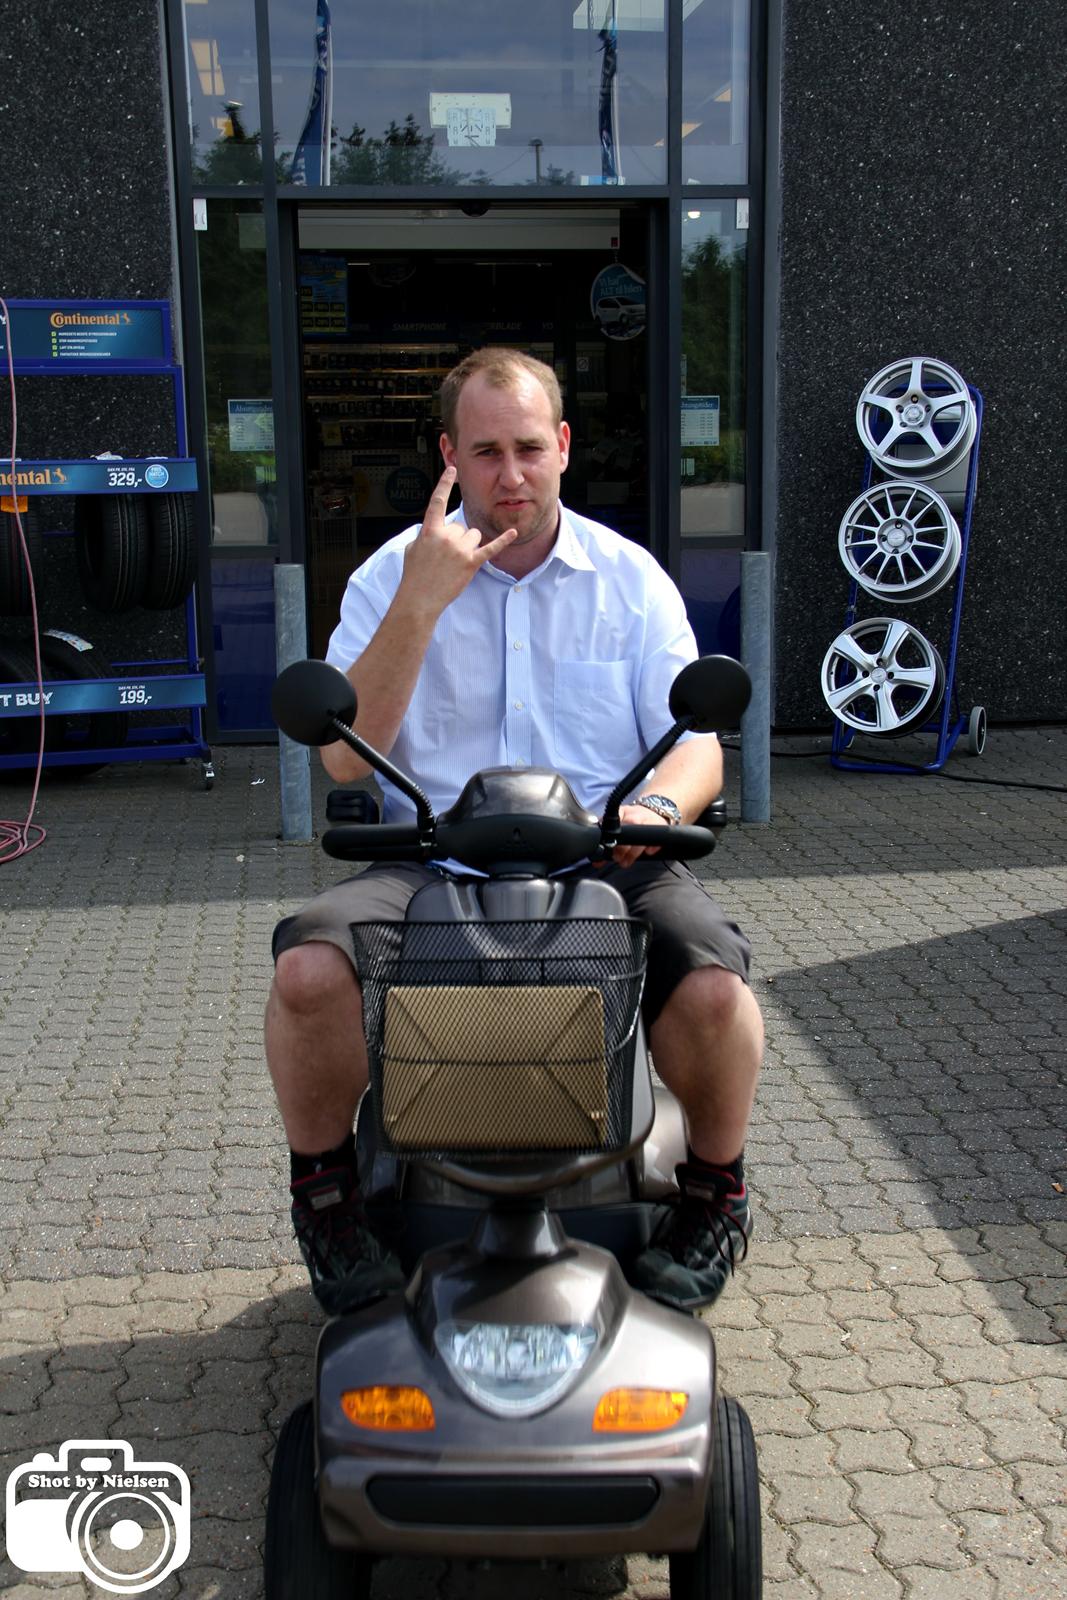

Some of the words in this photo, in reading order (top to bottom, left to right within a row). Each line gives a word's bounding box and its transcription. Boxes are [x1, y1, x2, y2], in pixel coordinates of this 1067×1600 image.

[50, 312, 120, 328] Continental
[392, 322, 448, 331] SMARTPHONE
[397, 478, 420, 489] PRIS
[390, 489, 425, 500] MATCH
[16, 691, 54, 706] BUY
